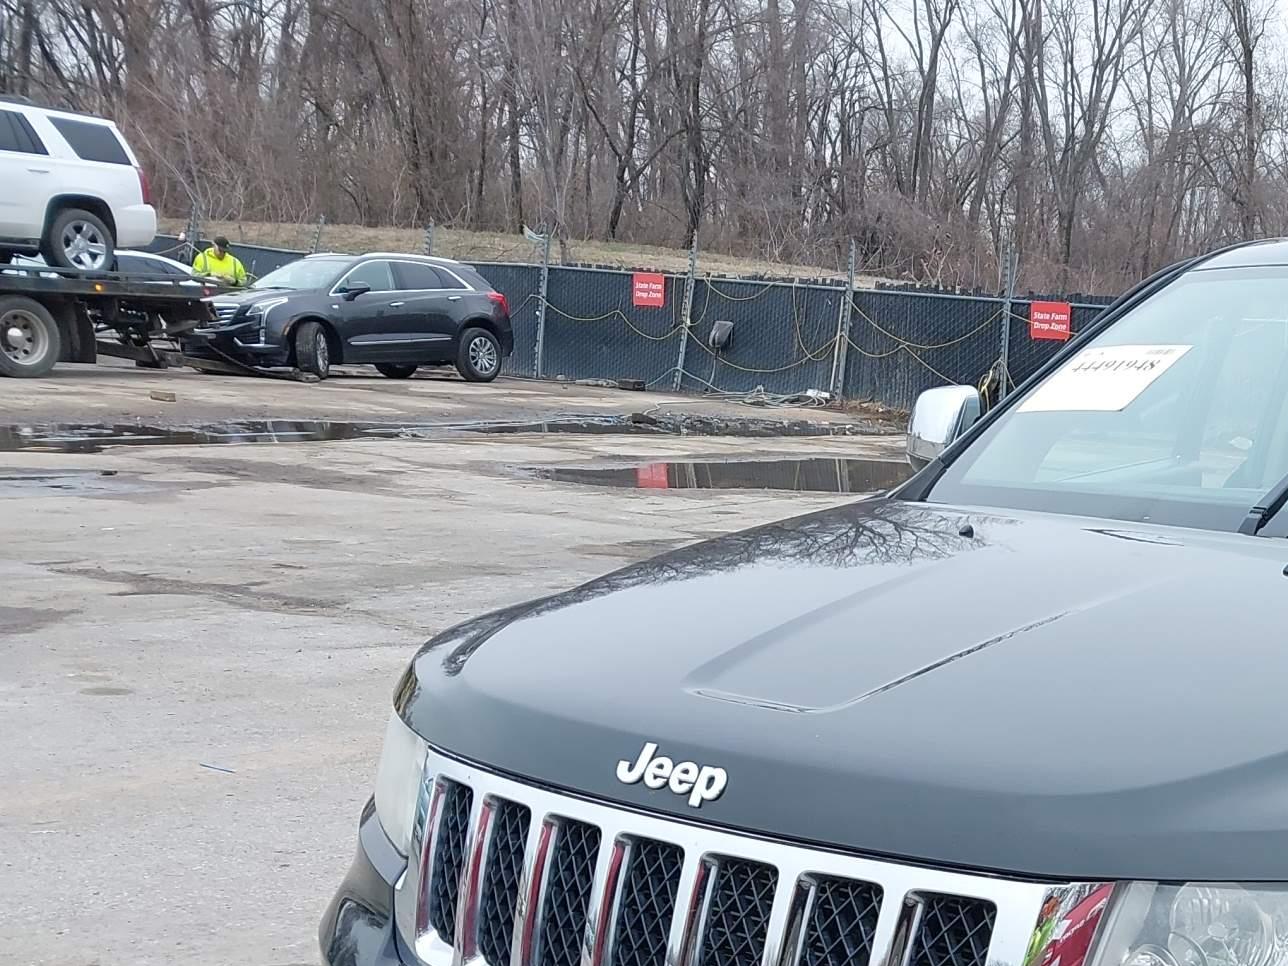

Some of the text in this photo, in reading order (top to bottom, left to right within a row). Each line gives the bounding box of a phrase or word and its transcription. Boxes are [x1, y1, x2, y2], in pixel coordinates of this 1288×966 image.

[1033, 312, 1068, 321] State Farm
[1033, 322, 1067, 331] Drop Zone
[616, 742, 728, 808] Jeep
